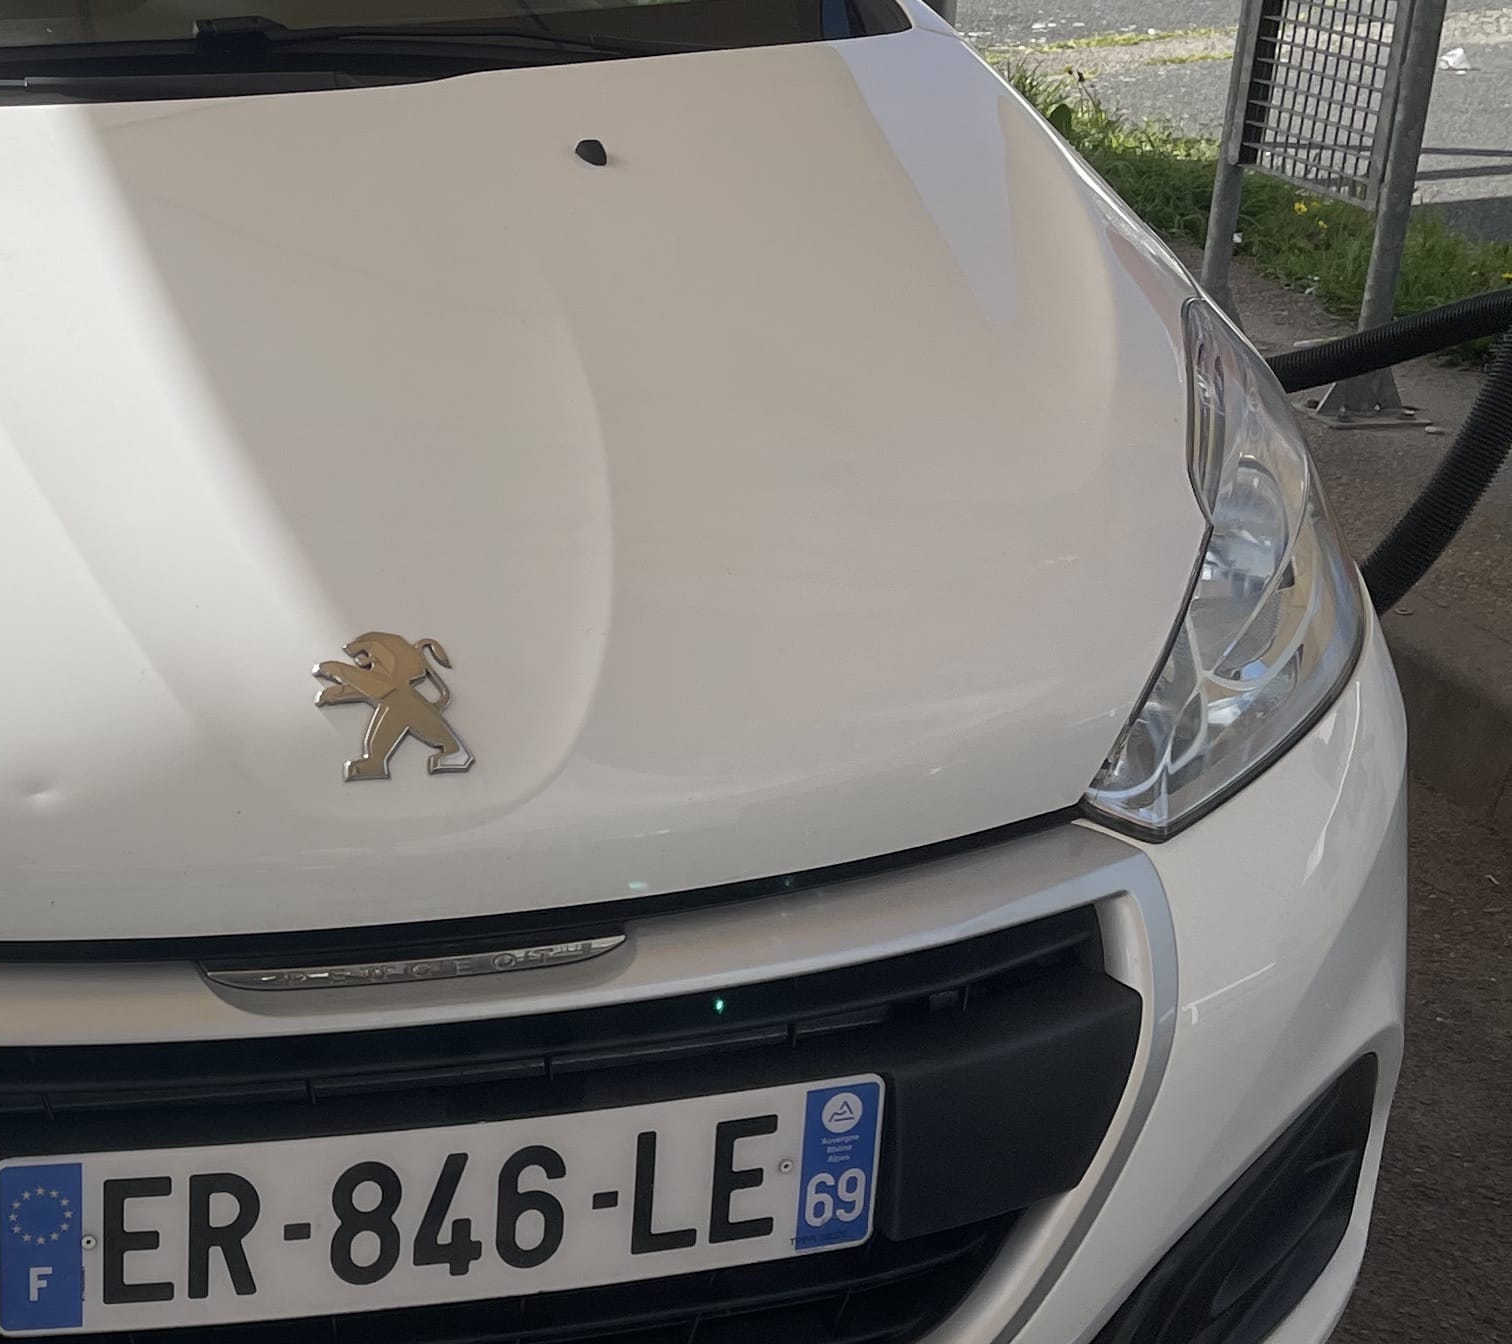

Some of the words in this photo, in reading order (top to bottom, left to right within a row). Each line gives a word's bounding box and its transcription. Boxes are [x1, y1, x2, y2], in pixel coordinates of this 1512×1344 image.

[102, 1113, 779, 1306] ER-846-LE
[804, 1167, 866, 1227] 69
[28, 1266, 53, 1302] F
